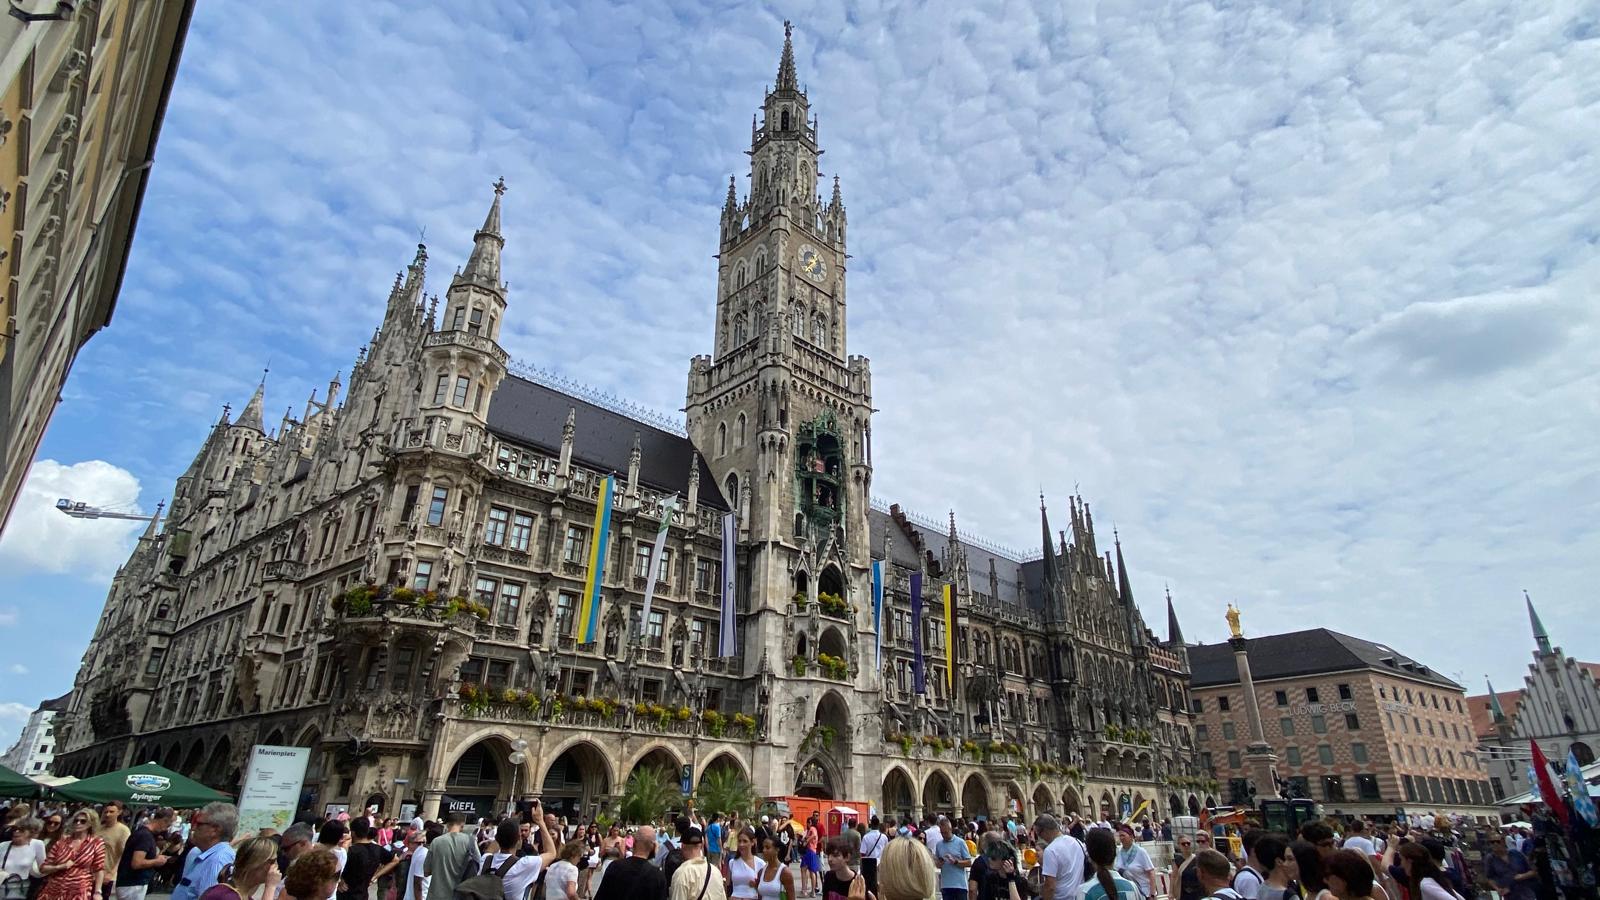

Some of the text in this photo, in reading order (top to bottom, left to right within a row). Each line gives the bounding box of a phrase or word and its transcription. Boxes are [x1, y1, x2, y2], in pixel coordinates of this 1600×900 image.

[1289, 701, 1358, 716] LUDWIG BECK
[258, 748, 297, 757] Marienplatz
[684, 766, 690, 778] S
[683, 780, 689, 792] U
[131, 792, 162, 802] Ayinger
[449, 801, 476, 811] KIEFL
